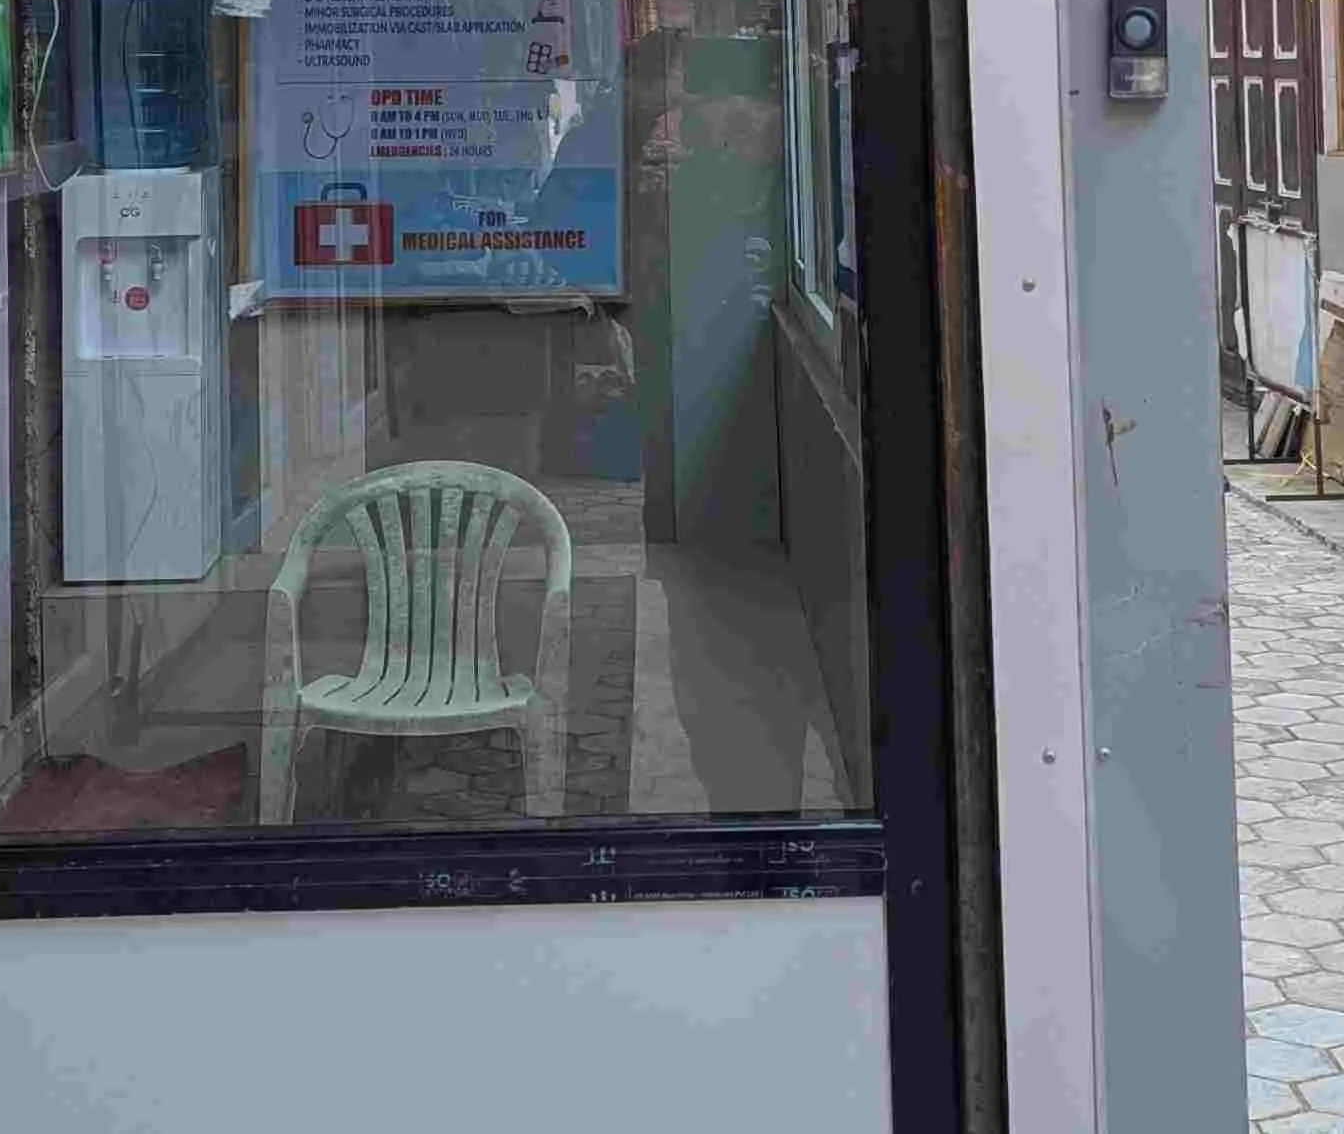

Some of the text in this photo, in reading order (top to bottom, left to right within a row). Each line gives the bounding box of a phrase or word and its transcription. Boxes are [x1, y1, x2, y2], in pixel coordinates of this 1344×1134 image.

[305, 54, 371, 67] ULTRASOUND
[370, 89, 444, 107] OPD TIME
[478, 211, 507, 228] FOR
[402, 230, 588, 251] MEDICAL ASSISTANCE
